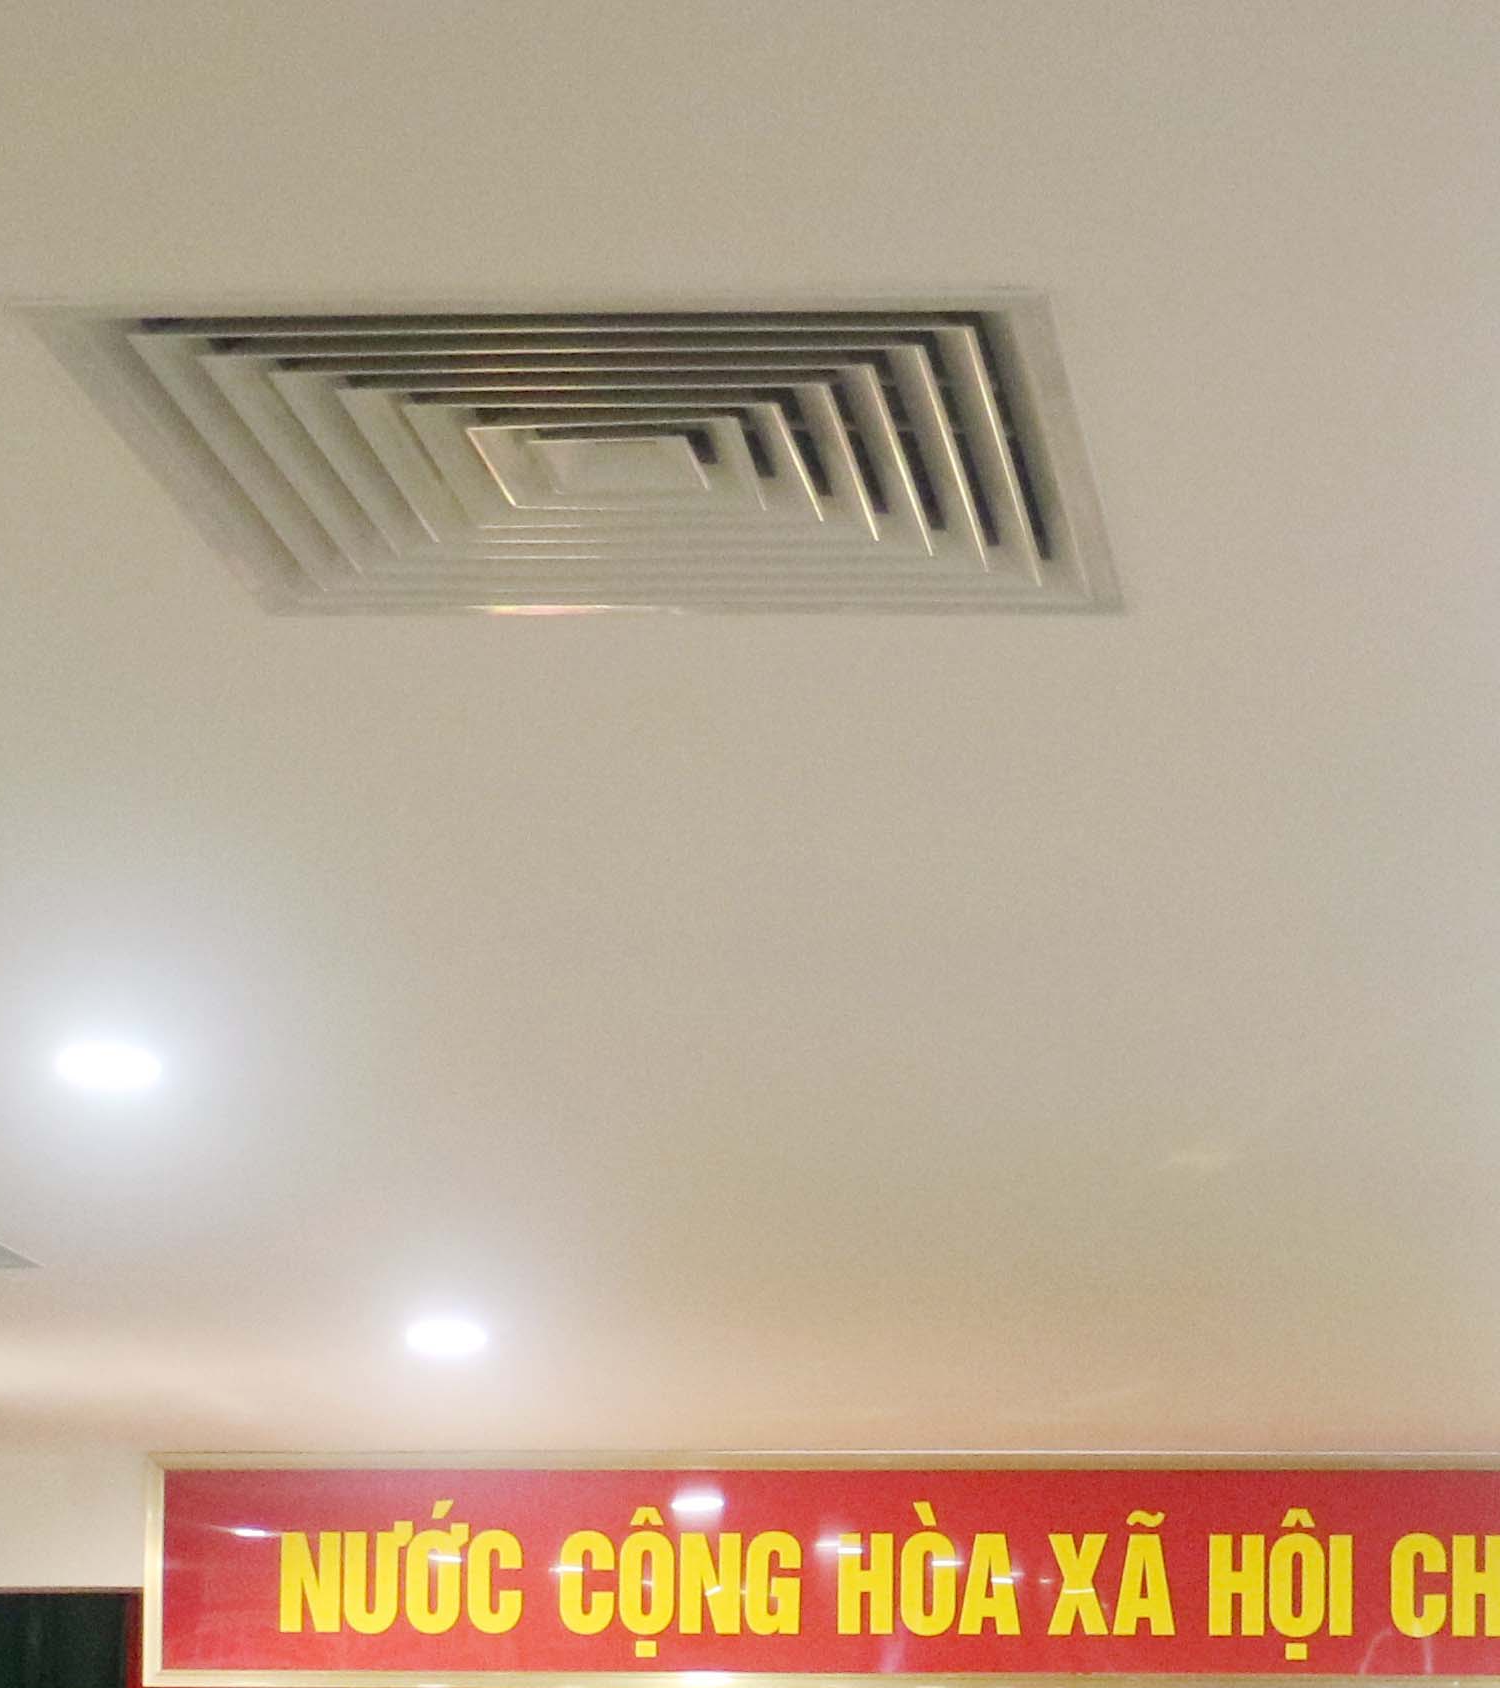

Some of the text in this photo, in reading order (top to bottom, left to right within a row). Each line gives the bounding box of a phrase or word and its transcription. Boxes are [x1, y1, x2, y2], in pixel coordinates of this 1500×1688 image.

[279, 1501, 524, 1634] NƯỚC
[559, 1507, 801, 1658] CỘNG
[837, 1502, 1020, 1636] HÒA
[1048, 1511, 1175, 1635] XÃ
[1209, 1509, 1352, 1660] HỘI
